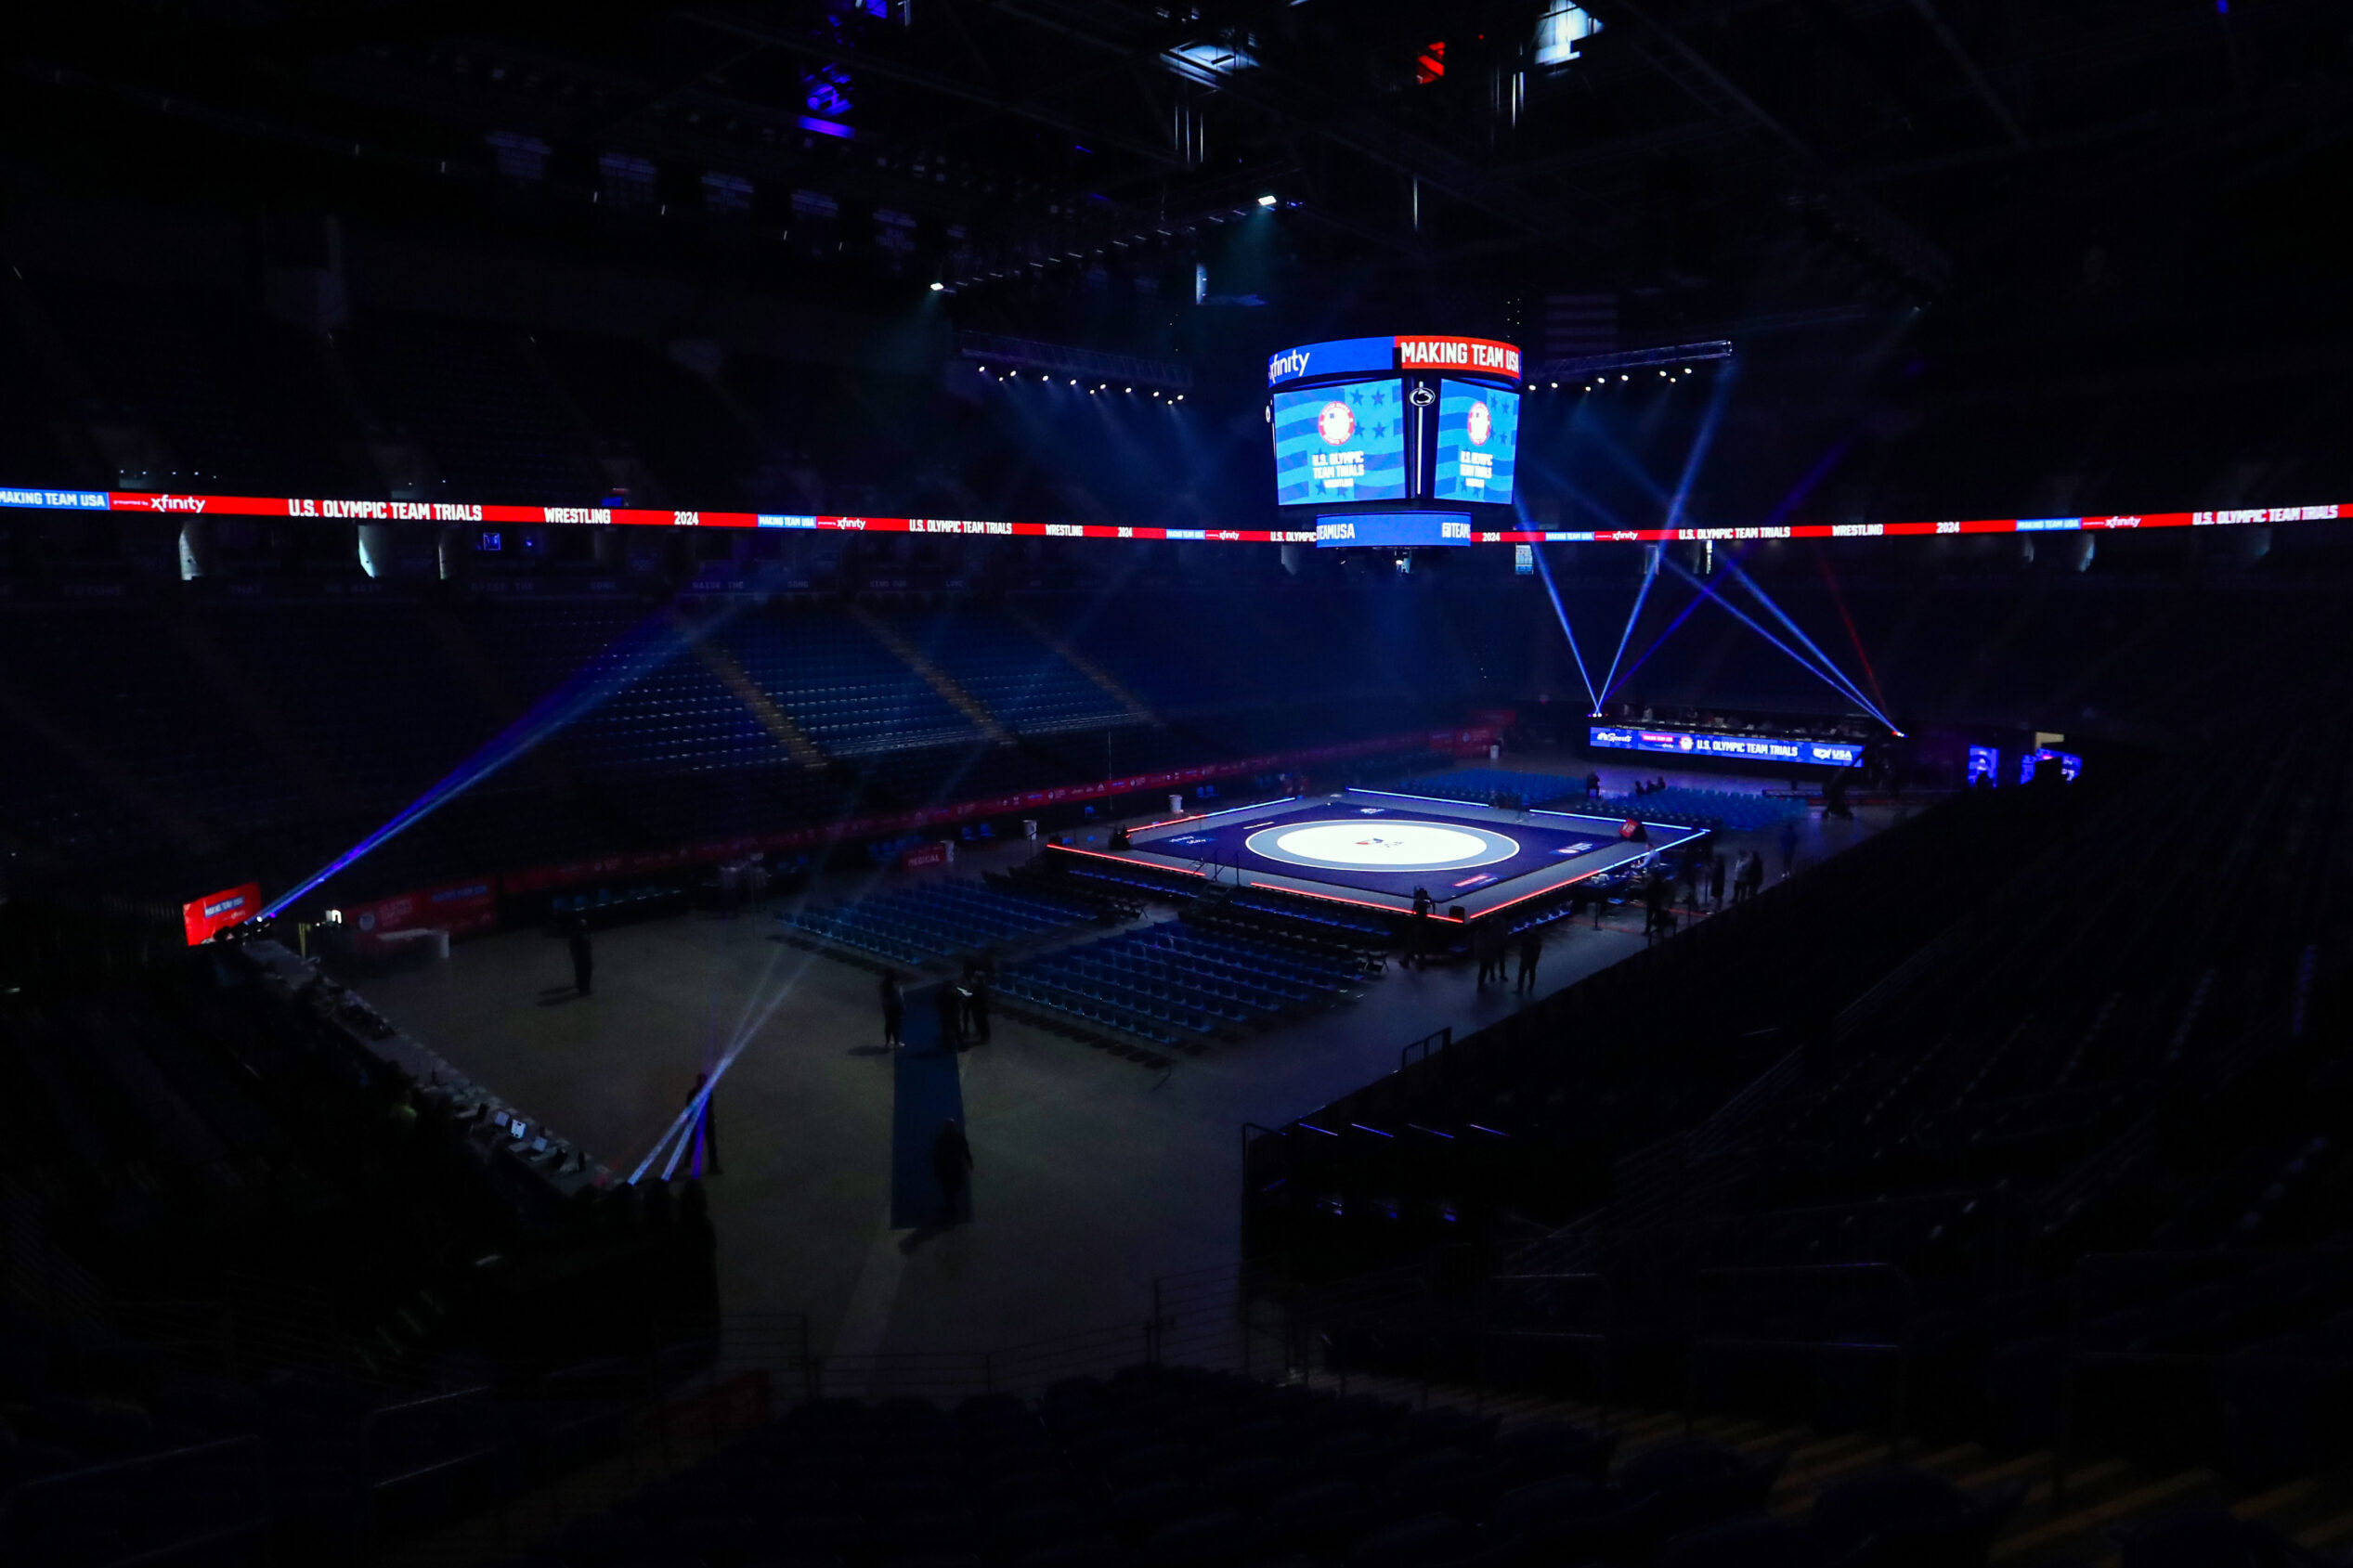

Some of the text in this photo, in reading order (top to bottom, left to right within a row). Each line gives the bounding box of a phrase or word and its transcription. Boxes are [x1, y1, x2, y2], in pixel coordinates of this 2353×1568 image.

[1400, 342, 1468, 364] MAKING
[1471, 344, 1504, 369] TEAM
[45, 493, 77, 506] TEAM
[81, 495, 106, 508] USA
[150, 495, 206, 514] xfinity
[288, 499, 483, 522] U.S. OLYMPIC TEAM TRIALS
[544, 507, 612, 525] WRESTLING
[2191, 504, 2339, 525] U.S. OLYMPIC TEAM TRIALS
[674, 511, 699, 525] 2024
[837, 516, 866, 531] xfinity
[2105, 515, 2141, 529] xfinity
[909, 519, 1013, 535] U.S. OLYMPIC TEAM TRIALS
[1045, 524, 1084, 538] WRESTLING
[1117, 526, 1134, 538] 2024
[1678, 525, 1791, 540] U.S. OLYMPIC TEAM TRIALS
[1831, 523, 1884, 537] WRESTLING
[1935, 522, 1960, 534] 2024
[1218, 529, 1240, 541] xfinity
[1270, 531, 1317, 542] U.S. OLYMPIC
[1482, 531, 1502, 542] 2024
[1612, 530, 1639, 542] xfinity
[1696, 739, 1799, 758] U.S. OLYMPIC TEAM TRIALS
[1831, 749, 1853, 760] USA
